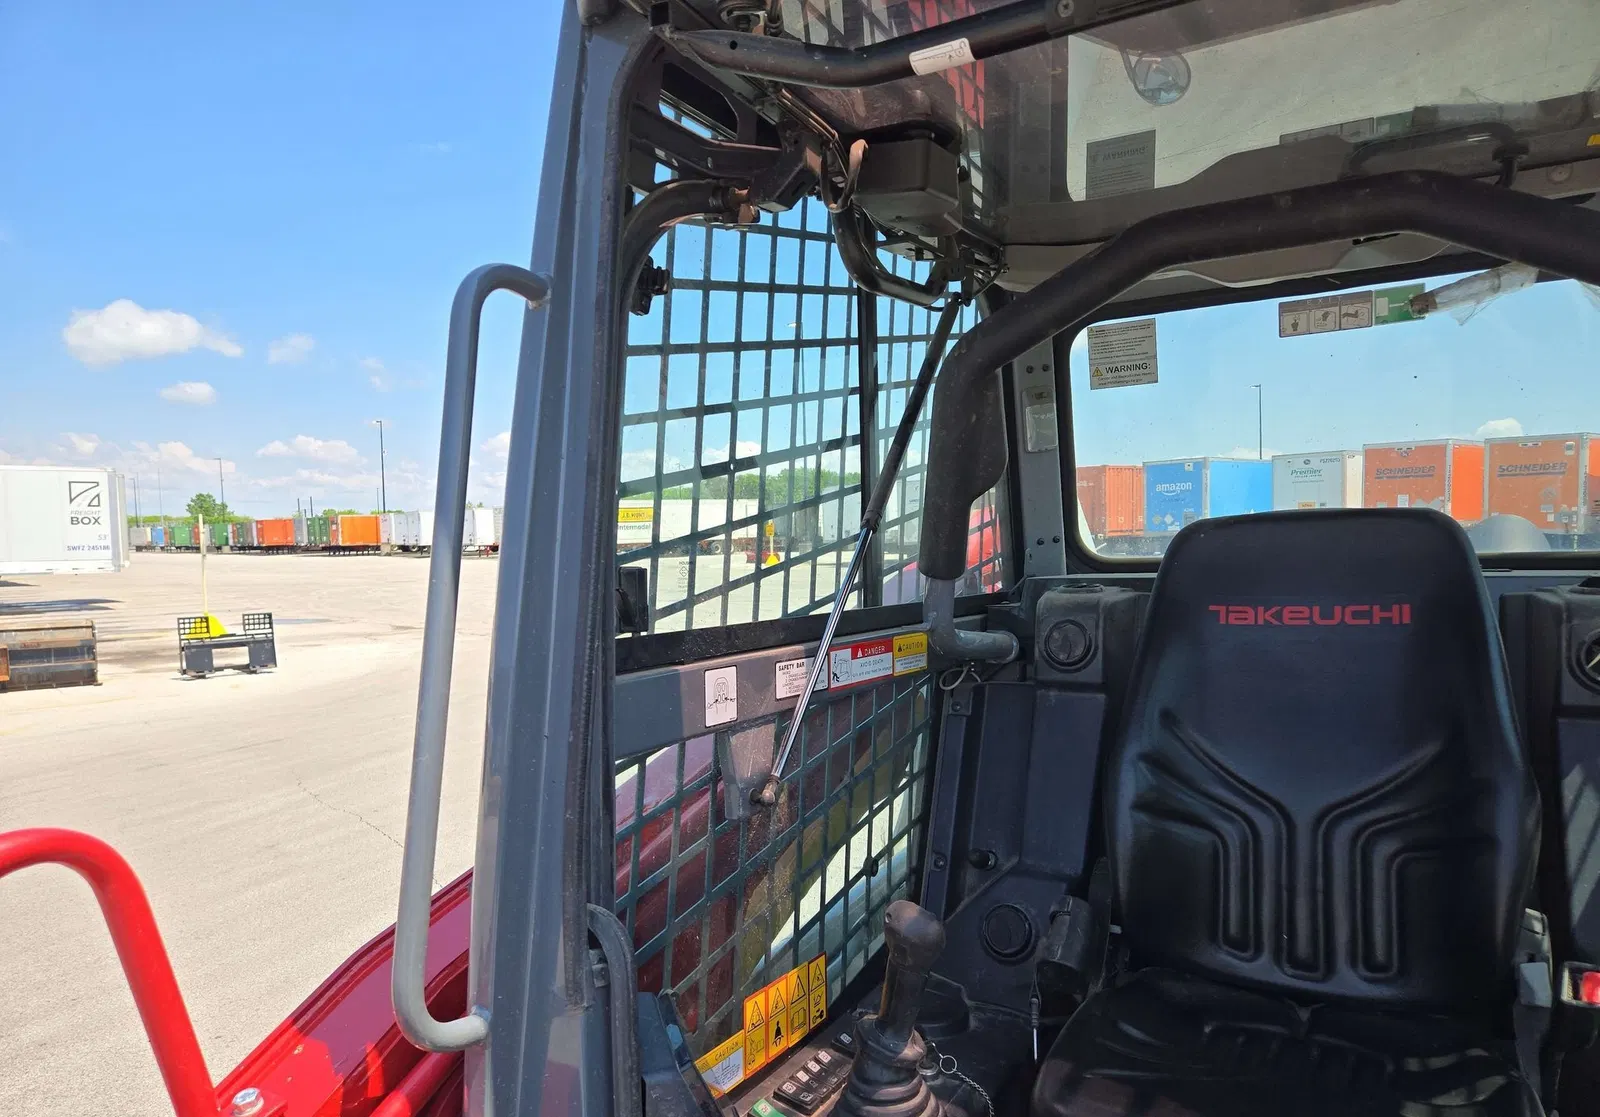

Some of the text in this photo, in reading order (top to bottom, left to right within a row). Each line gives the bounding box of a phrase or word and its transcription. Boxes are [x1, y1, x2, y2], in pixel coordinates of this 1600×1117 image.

[1306, 296, 1342, 306] EXIT
[1105, 362, 1151, 374] WARNING:
[1290, 468, 1324, 476] Premier
[1375, 465, 1436, 476] SCHNEIDER
[1497, 462, 1568, 473] SCHNEIDER
[1155, 482, 1192, 492] amazon
[70, 516, 101, 525] BOX
[1208, 603, 1412, 626] TAKEUCHI
[864, 645, 886, 657] DANGER
[902, 641, 924, 651] CAUTION
[778, 661, 805, 672] SAFETY BAR
[714, 1041, 739, 1061] CAUTION
